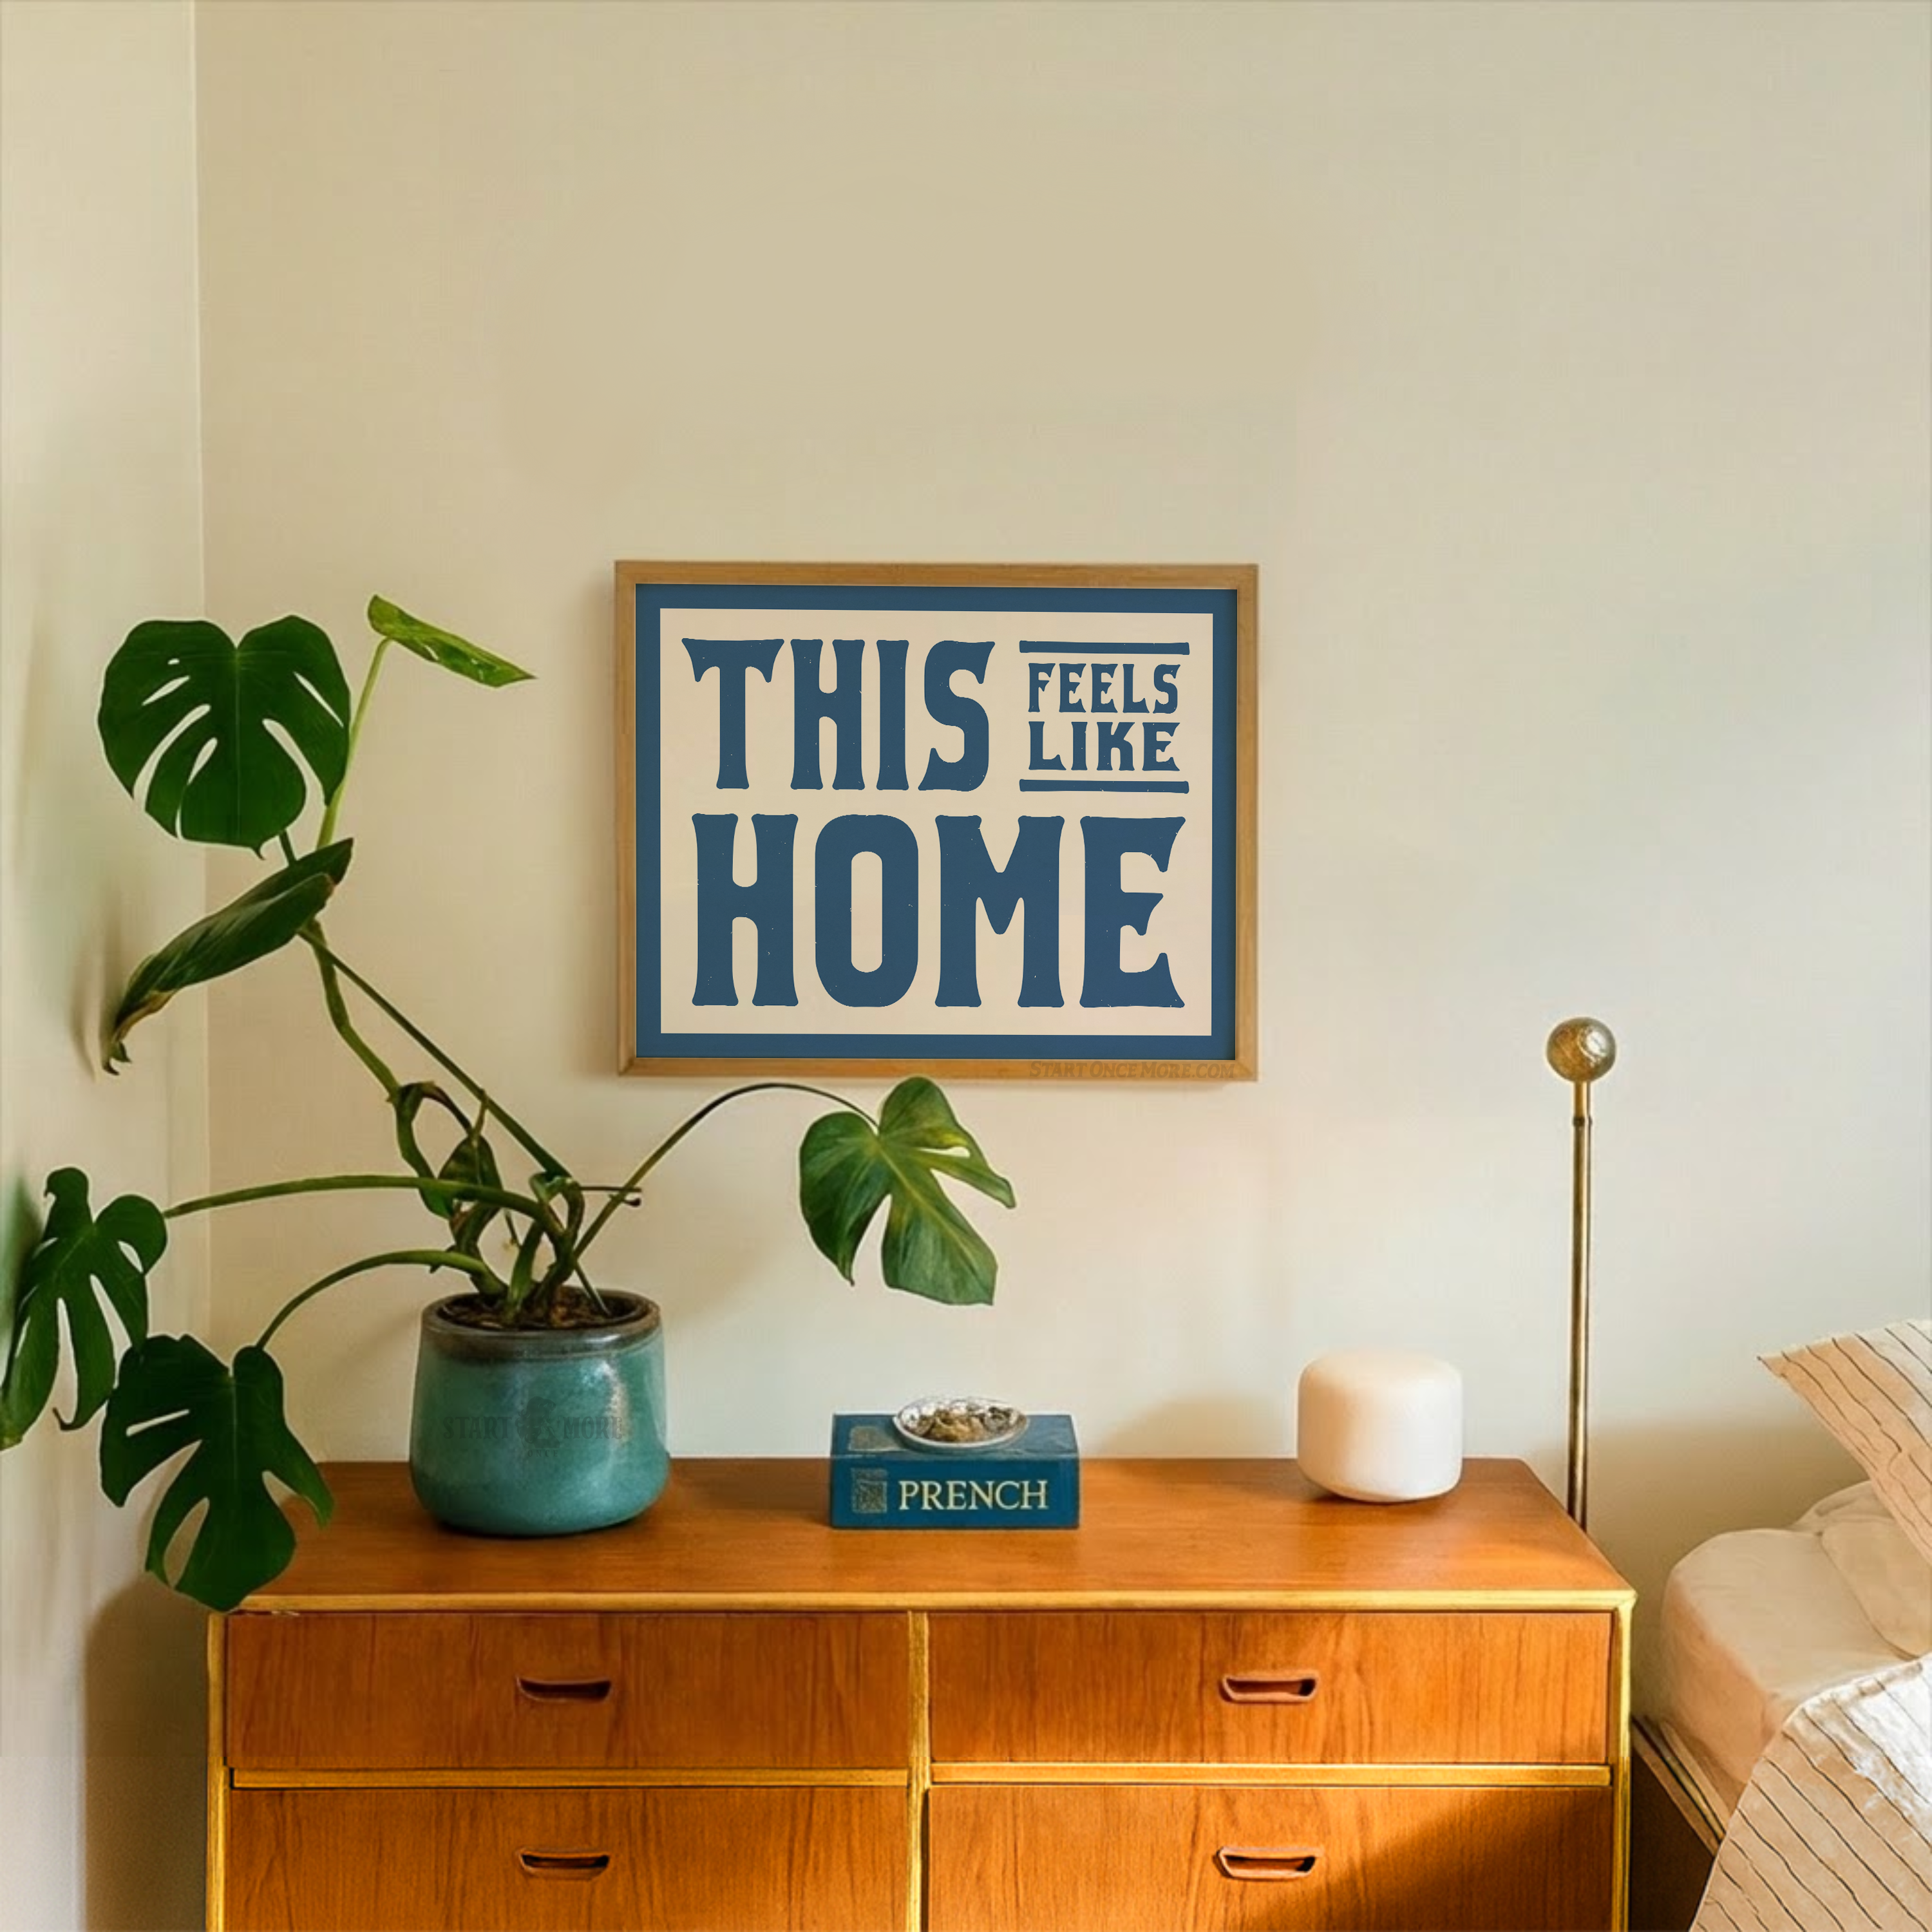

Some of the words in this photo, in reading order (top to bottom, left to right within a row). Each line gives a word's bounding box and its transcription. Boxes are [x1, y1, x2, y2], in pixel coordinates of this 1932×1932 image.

[1028, 662, 1181, 714] FEELS
[681, 638, 996, 792] THIS
[1028, 721, 1181, 772] LIKE
[691, 813, 1186, 1009] HOME
[899, 1480, 1048, 1511] PRENCH
